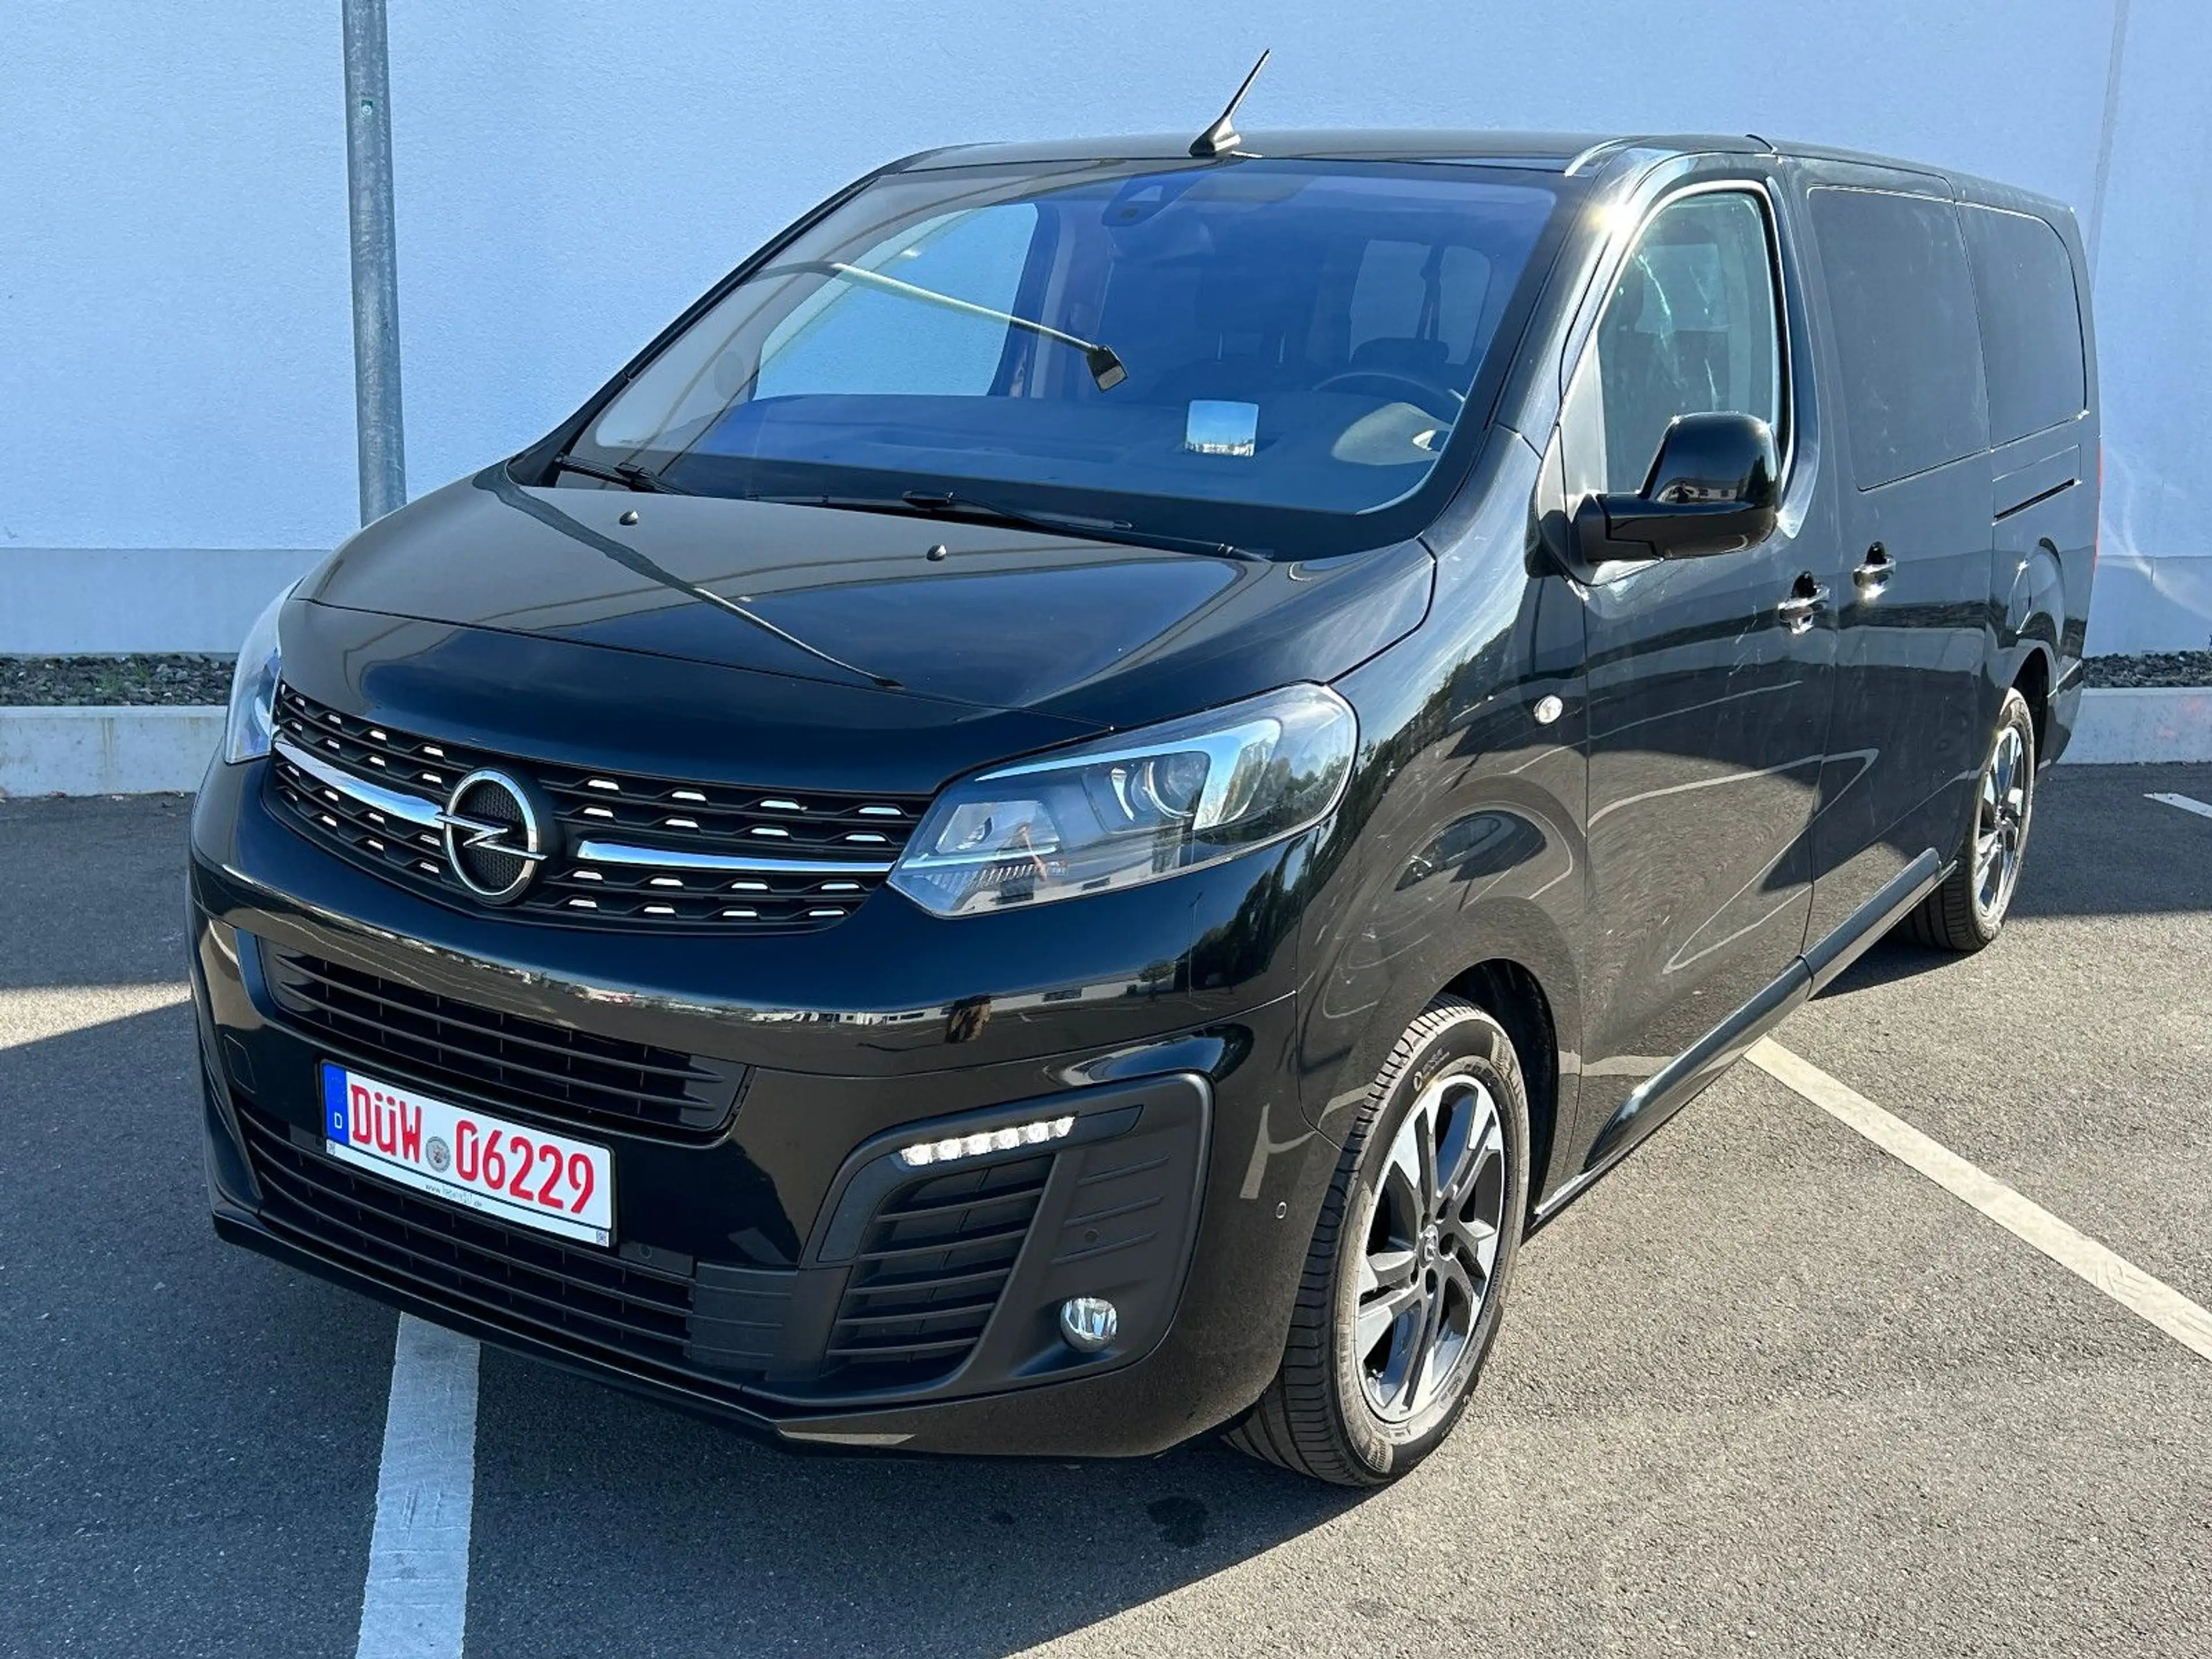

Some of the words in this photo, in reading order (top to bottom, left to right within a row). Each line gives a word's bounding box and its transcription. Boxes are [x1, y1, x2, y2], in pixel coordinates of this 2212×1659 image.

[334, 1111, 343, 1129] D
[350, 1084, 422, 1163] DÜW
[456, 1119, 594, 1214] 06229
